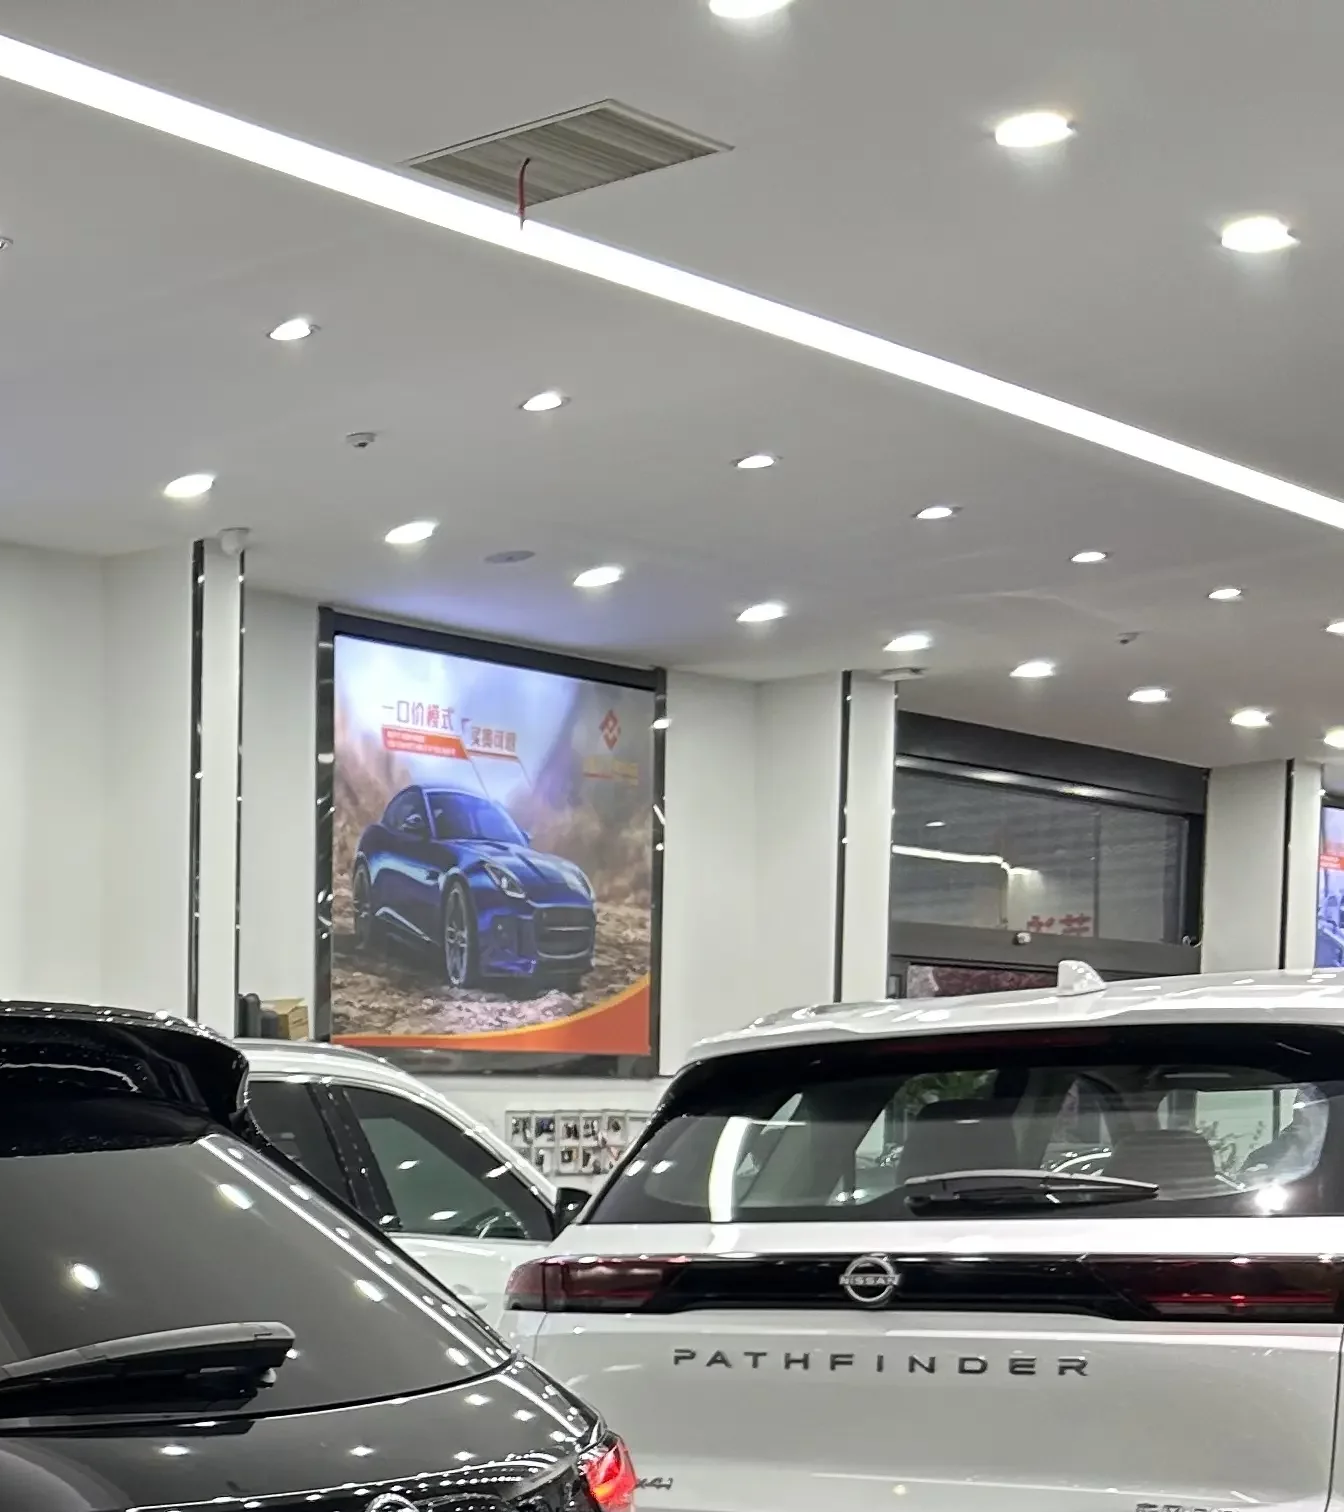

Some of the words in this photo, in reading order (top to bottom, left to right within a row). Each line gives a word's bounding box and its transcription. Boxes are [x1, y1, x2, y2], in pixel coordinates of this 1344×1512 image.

[382, 700, 454, 731] 一口价模式
[839, 1274, 900, 1286] NISSAN
[673, 1348, 1089, 1377] PATHFINDER
